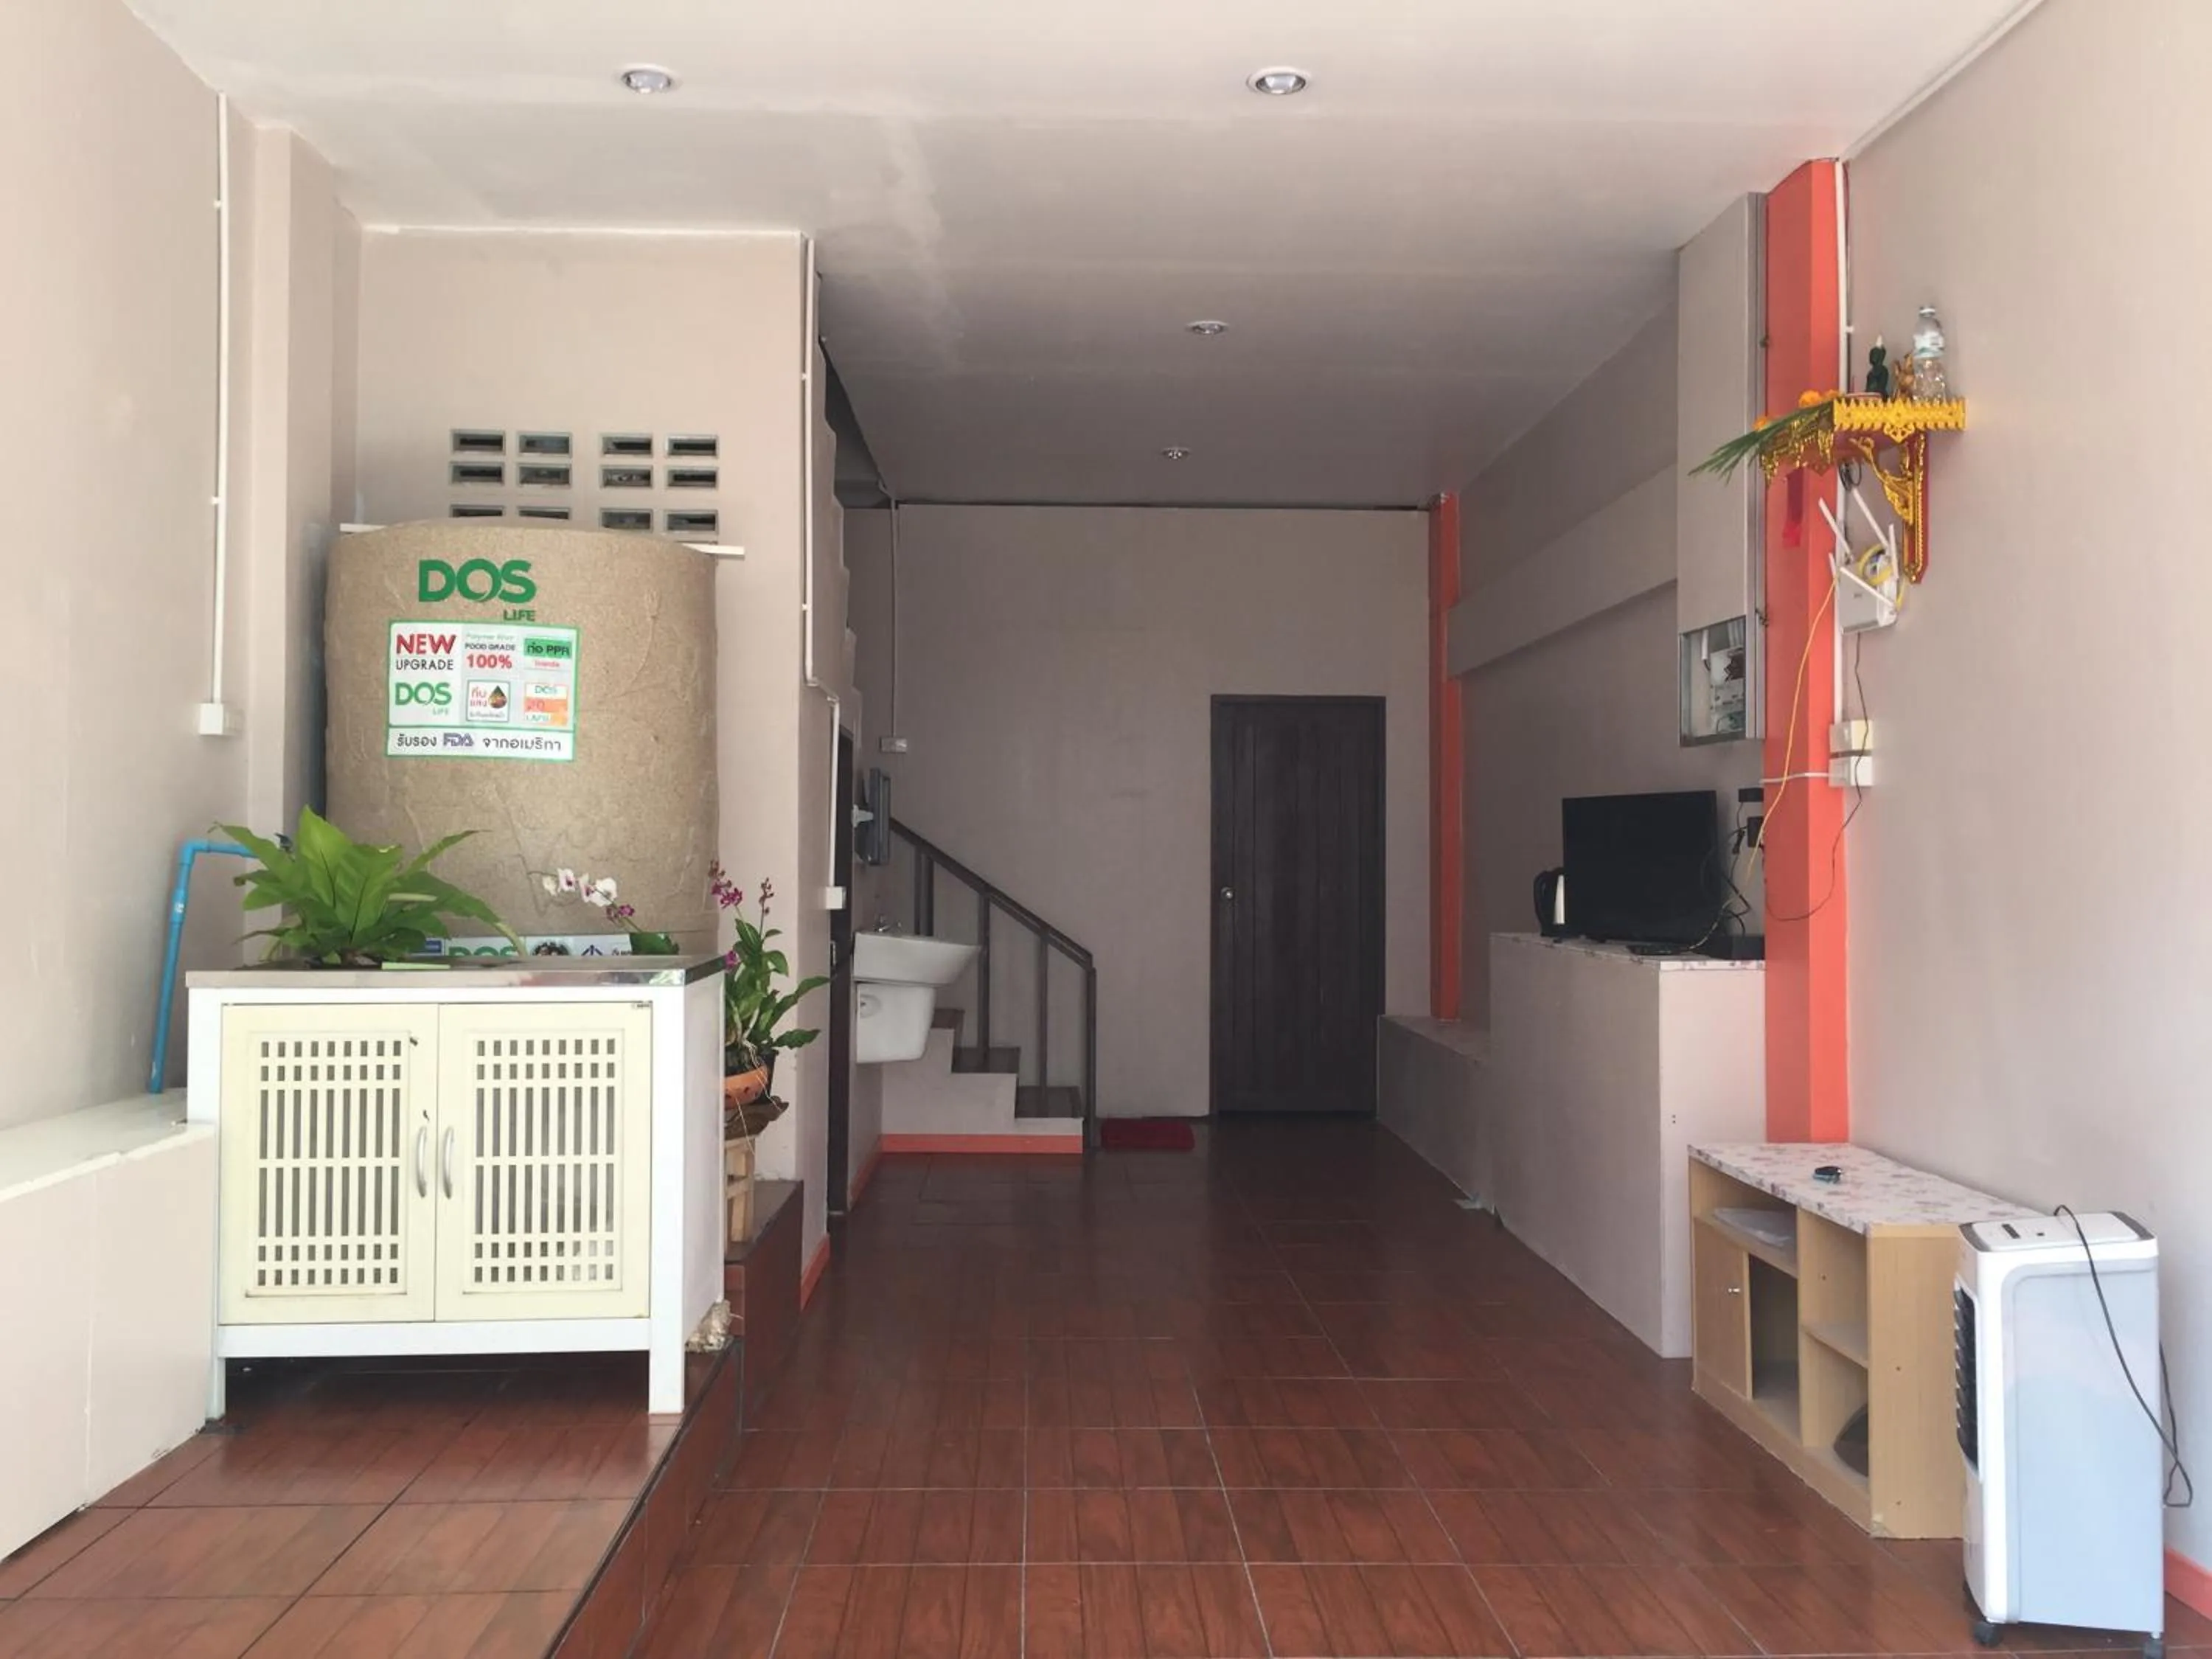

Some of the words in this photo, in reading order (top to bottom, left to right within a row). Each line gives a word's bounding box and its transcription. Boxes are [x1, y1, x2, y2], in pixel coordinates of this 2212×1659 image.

[418, 558, 537, 603] DOS
[503, 610, 536, 621] LIFE
[396, 634, 456, 655] NEW
[396, 659, 453, 670] UPGRADE
[466, 654, 512, 669] 100%
[394, 683, 452, 705] DOS
[443, 733, 474, 747] FDA
